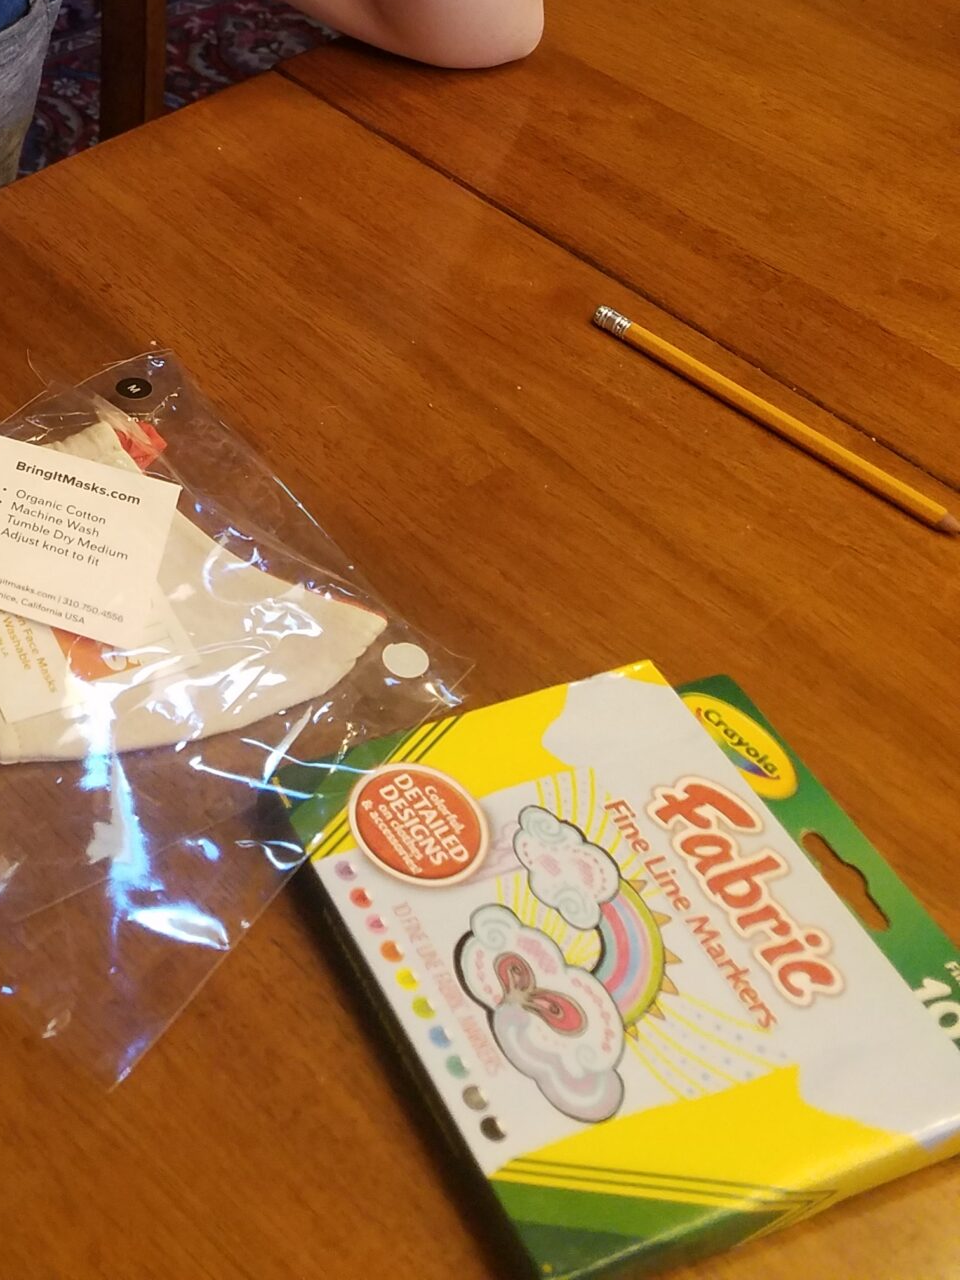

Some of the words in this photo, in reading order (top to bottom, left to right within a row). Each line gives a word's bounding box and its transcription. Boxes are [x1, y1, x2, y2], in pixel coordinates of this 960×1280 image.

[15, 460, 141, 505] BringItMasks.com
[10, 501, 63, 525] Machine
[67, 520, 100, 537] Wash
[15, 489, 62, 511] Organic
[66, 505, 107, 525] Cotton
[1, 527, 39, 548] Adjust
[42, 540, 70, 557] knot
[72, 551, 84, 562] to
[88, 554, 100, 567] fit
[7, 514, 50, 536] Tumble
[53, 529, 75, 545] Dry
[77, 538, 129, 561] Medium
[20, 598, 63, 618] California
[65, 612, 86, 625] USA
[2, 616, 32, 670] Washable
[22, 624, 39, 655] Face
[703, 708, 778, 775] Crayola
[378, 804, 393, 820] on
[379, 784, 449, 866] DESIGNS
[393, 773, 469, 863] DETAILED
[604, 799, 651, 855] Fine
[644, 855, 691, 913] Line
[685, 914, 779, 1030] Markers
